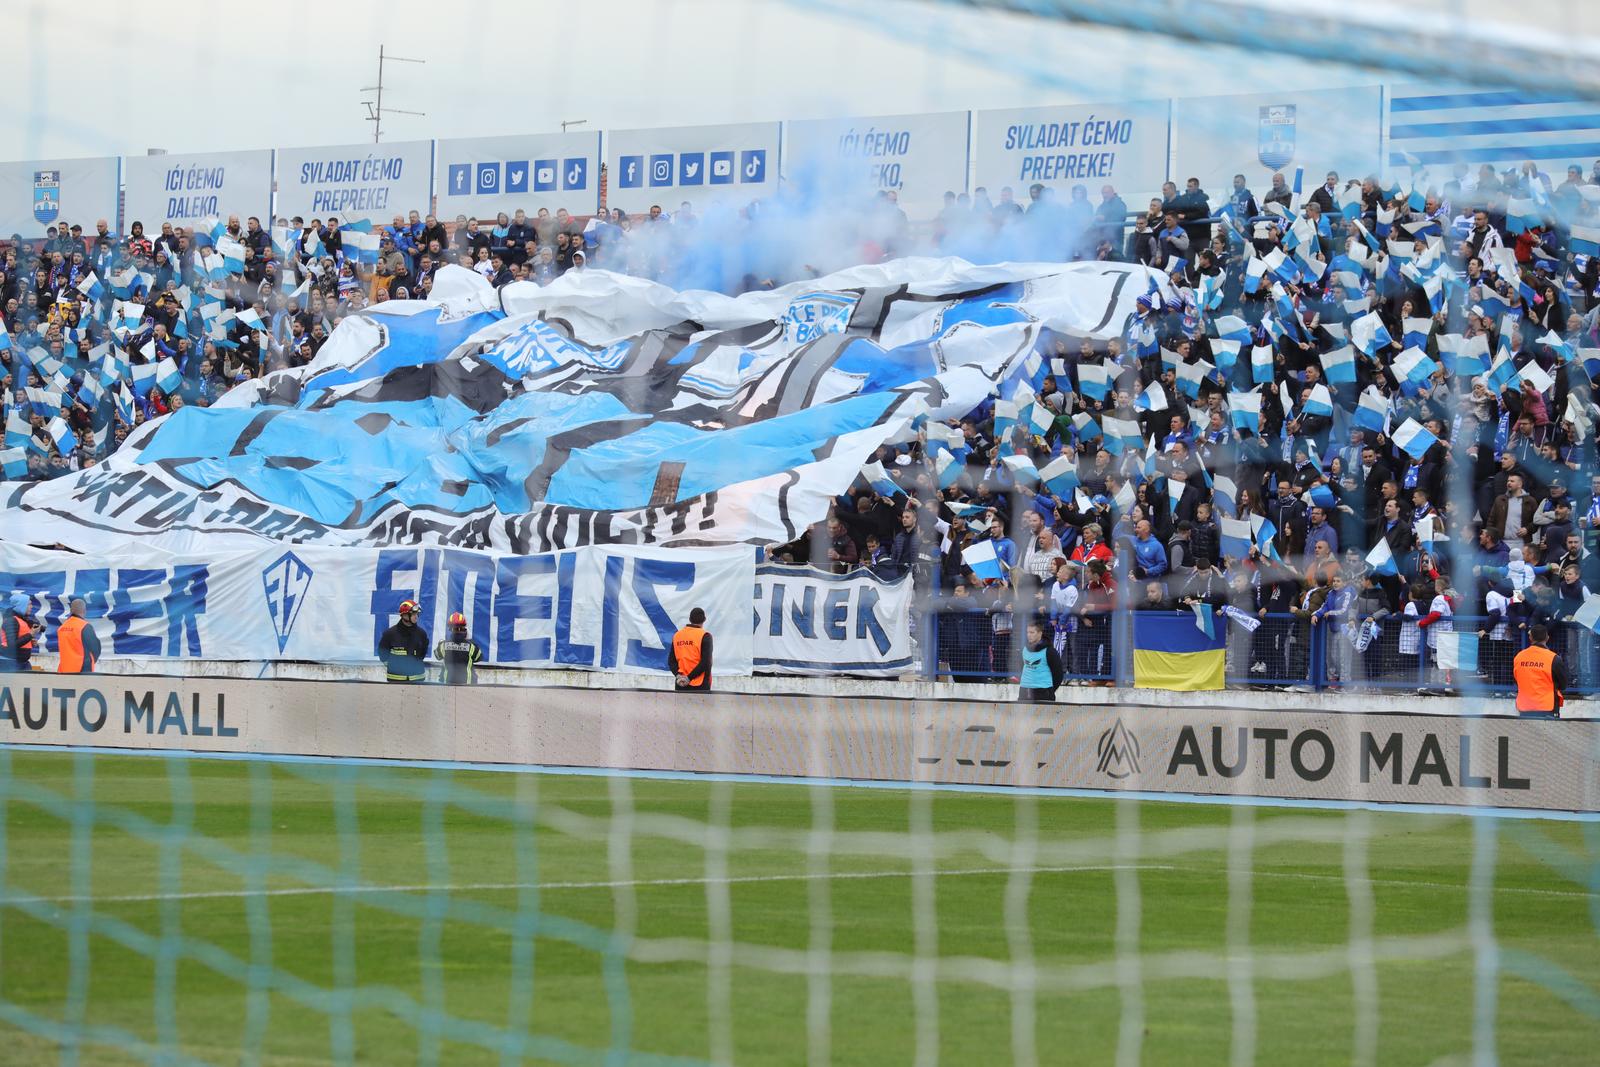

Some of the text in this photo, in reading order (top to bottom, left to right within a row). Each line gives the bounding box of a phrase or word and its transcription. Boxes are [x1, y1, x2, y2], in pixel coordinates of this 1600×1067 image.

[863, 127, 910, 156] ĆEMO
[1005, 115, 1133, 151] SVLADAT ĆEMO
[165, 162, 225, 191] IĆI ĆEMO
[300, 153, 403, 185] SVLADAT ĆEMO
[1020, 153, 1115, 181] PREPREKE!
[166, 195, 220, 219] DALEKO,
[312, 187, 389, 212] PREPREKE!
[0, 687, 239, 737] AUTO MALL
[1166, 725, 1531, 790] AUTO MALL
